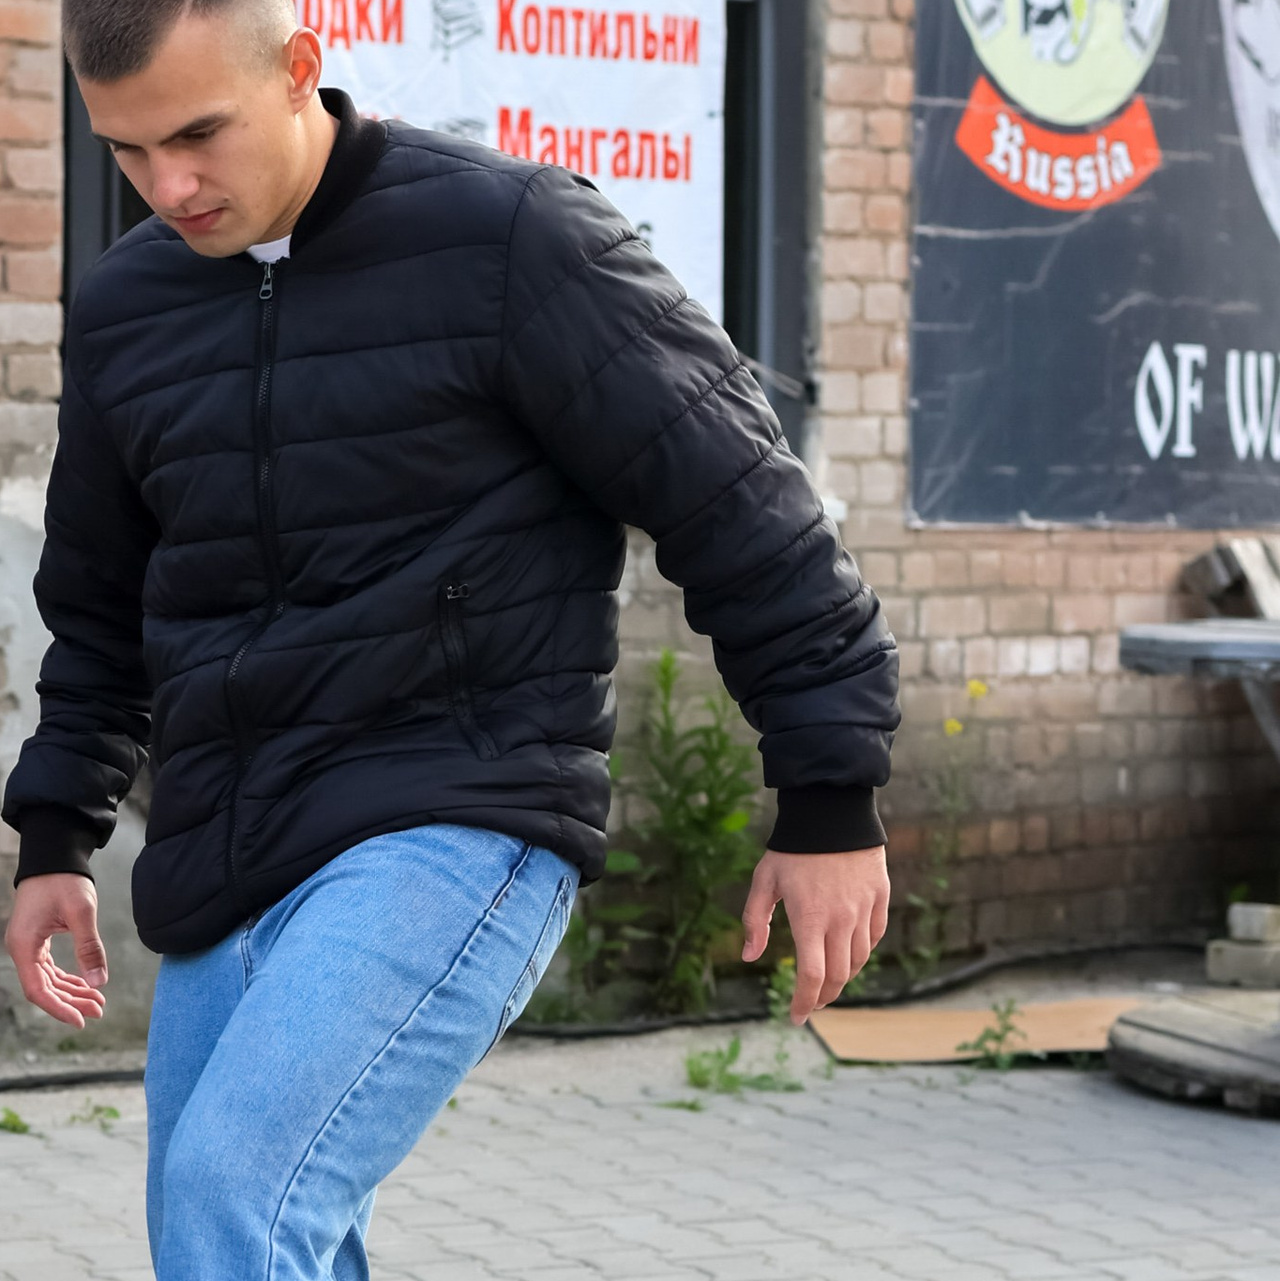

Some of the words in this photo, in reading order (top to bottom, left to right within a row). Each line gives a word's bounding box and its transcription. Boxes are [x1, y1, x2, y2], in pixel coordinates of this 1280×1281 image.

[497, 105, 692, 181] Мангалы
[984, 112, 1135, 200] Russia
[1133, 339, 1208, 461] OF
